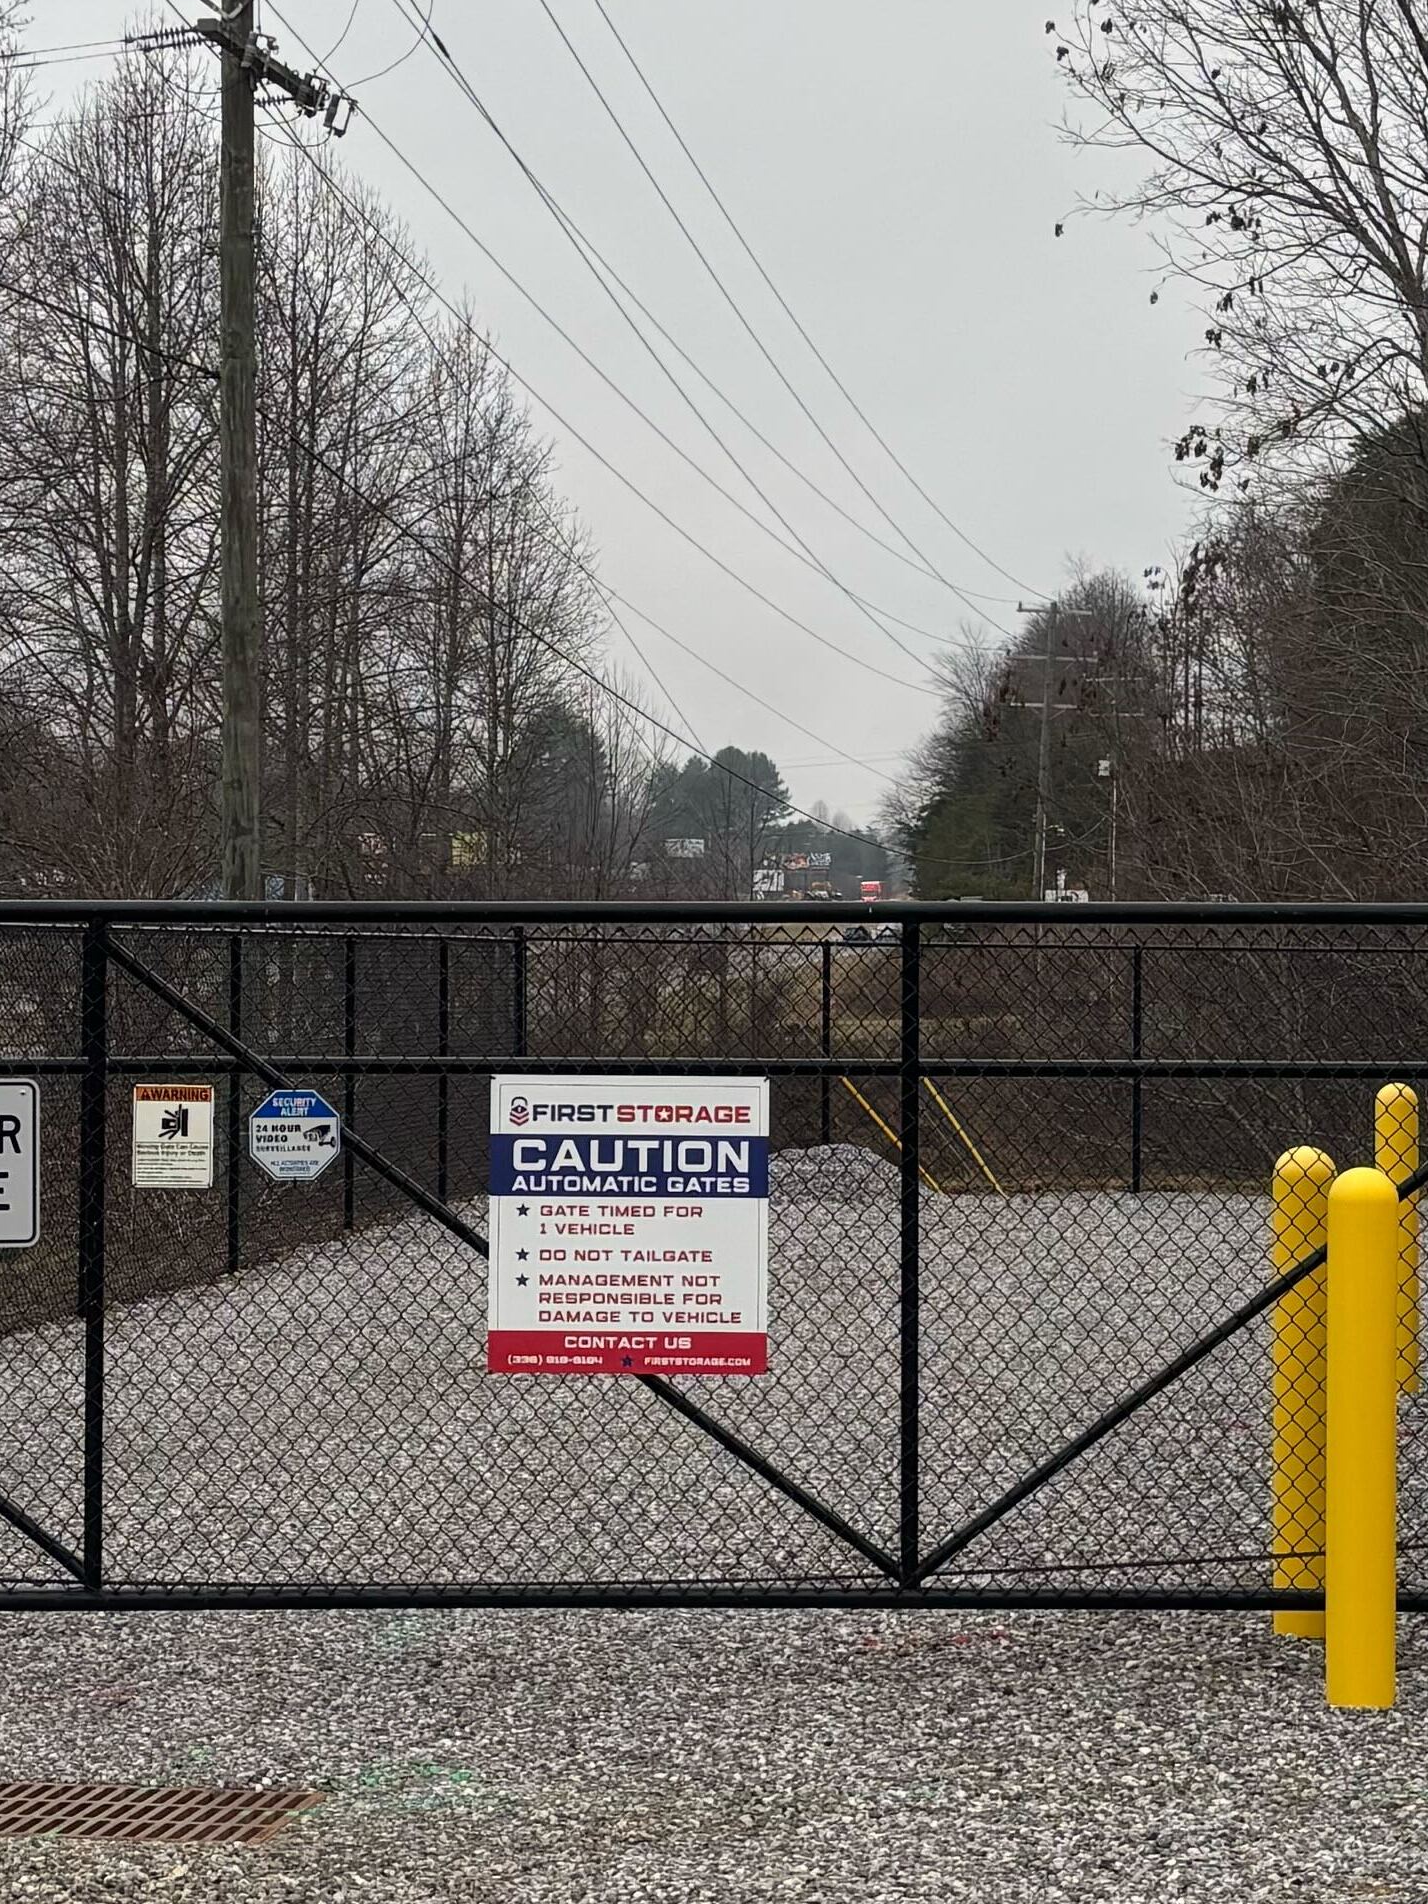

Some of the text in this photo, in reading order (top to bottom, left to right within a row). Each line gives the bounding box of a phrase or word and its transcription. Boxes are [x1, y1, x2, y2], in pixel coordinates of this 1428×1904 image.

[150, 1088, 209, 1101] WARNING
[272, 1097, 317, 1107] SECURITY
[280, 1107, 309, 1116] ALERT
[256, 1124, 301, 1132] 24 HOUR
[255, 1135, 288, 1143] VIDEO
[256, 1144, 311, 1152] SURVEILLANCE
[512, 1139, 749, 1173] CAUTION
[511, 1175, 750, 1193] AUTOMATIC GATES
[540, 1205, 703, 1218] GATE TIMED FOR
[540, 1223, 635, 1235] 1 VEHICLE
[539, 1249, 713, 1263] DO NOT TAILGATE
[539, 1274, 721, 1287] MANAGEMENT NOT
[539, 1292, 722, 1305] RESPONSIBLE FOR
[539, 1310, 742, 1324] DAMAGE TO VEHICLE
[564, 1336, 691, 1349] CONTACT US
[644, 1356, 751, 1366] FIRSTSTORAGE.COM
